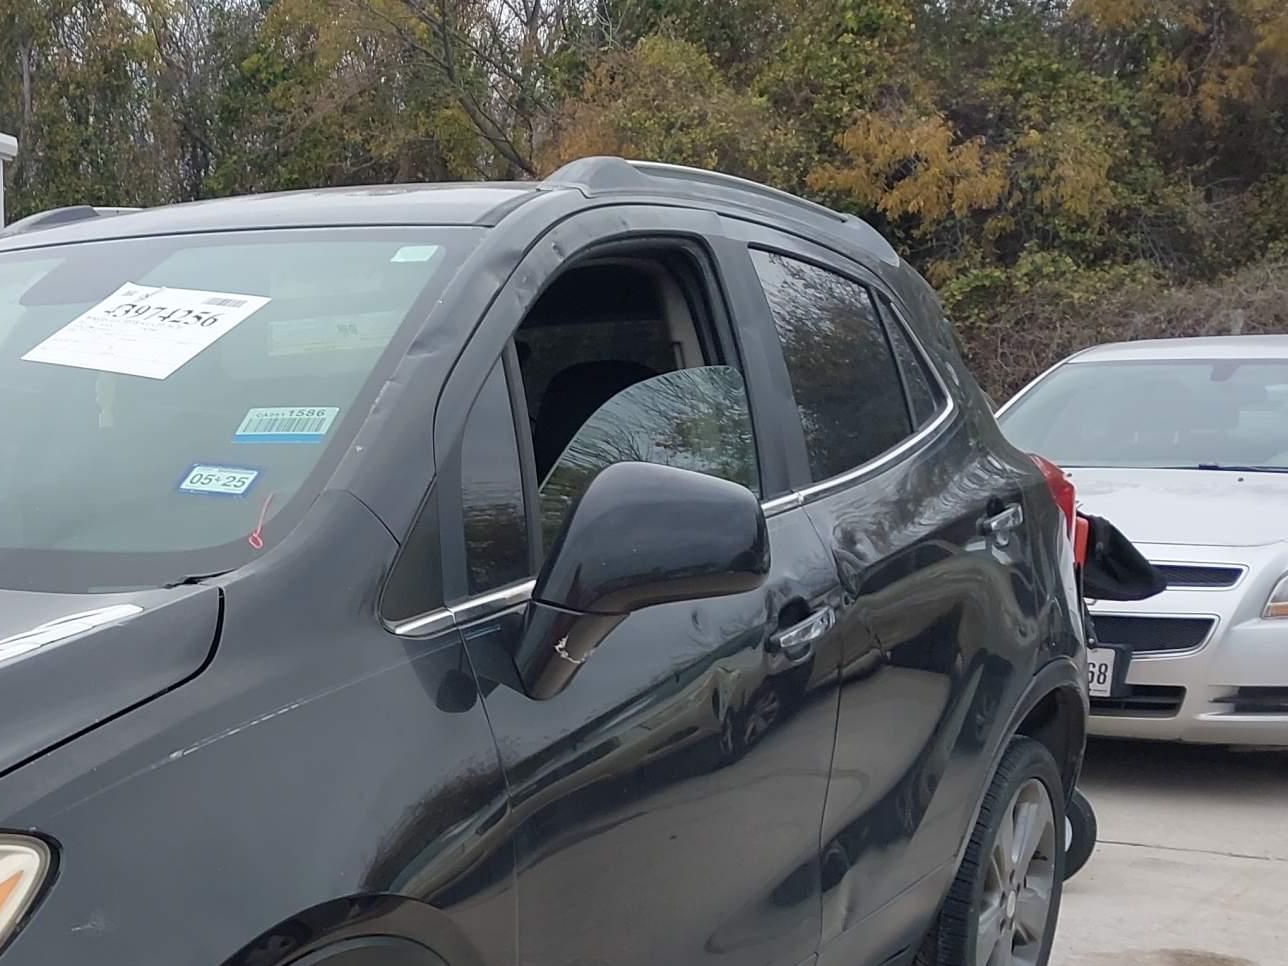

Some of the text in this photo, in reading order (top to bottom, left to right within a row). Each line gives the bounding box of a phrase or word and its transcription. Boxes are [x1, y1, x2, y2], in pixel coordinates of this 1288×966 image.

[288, 408, 327, 418] 1586
[189, 472, 250, 489] 05 25
